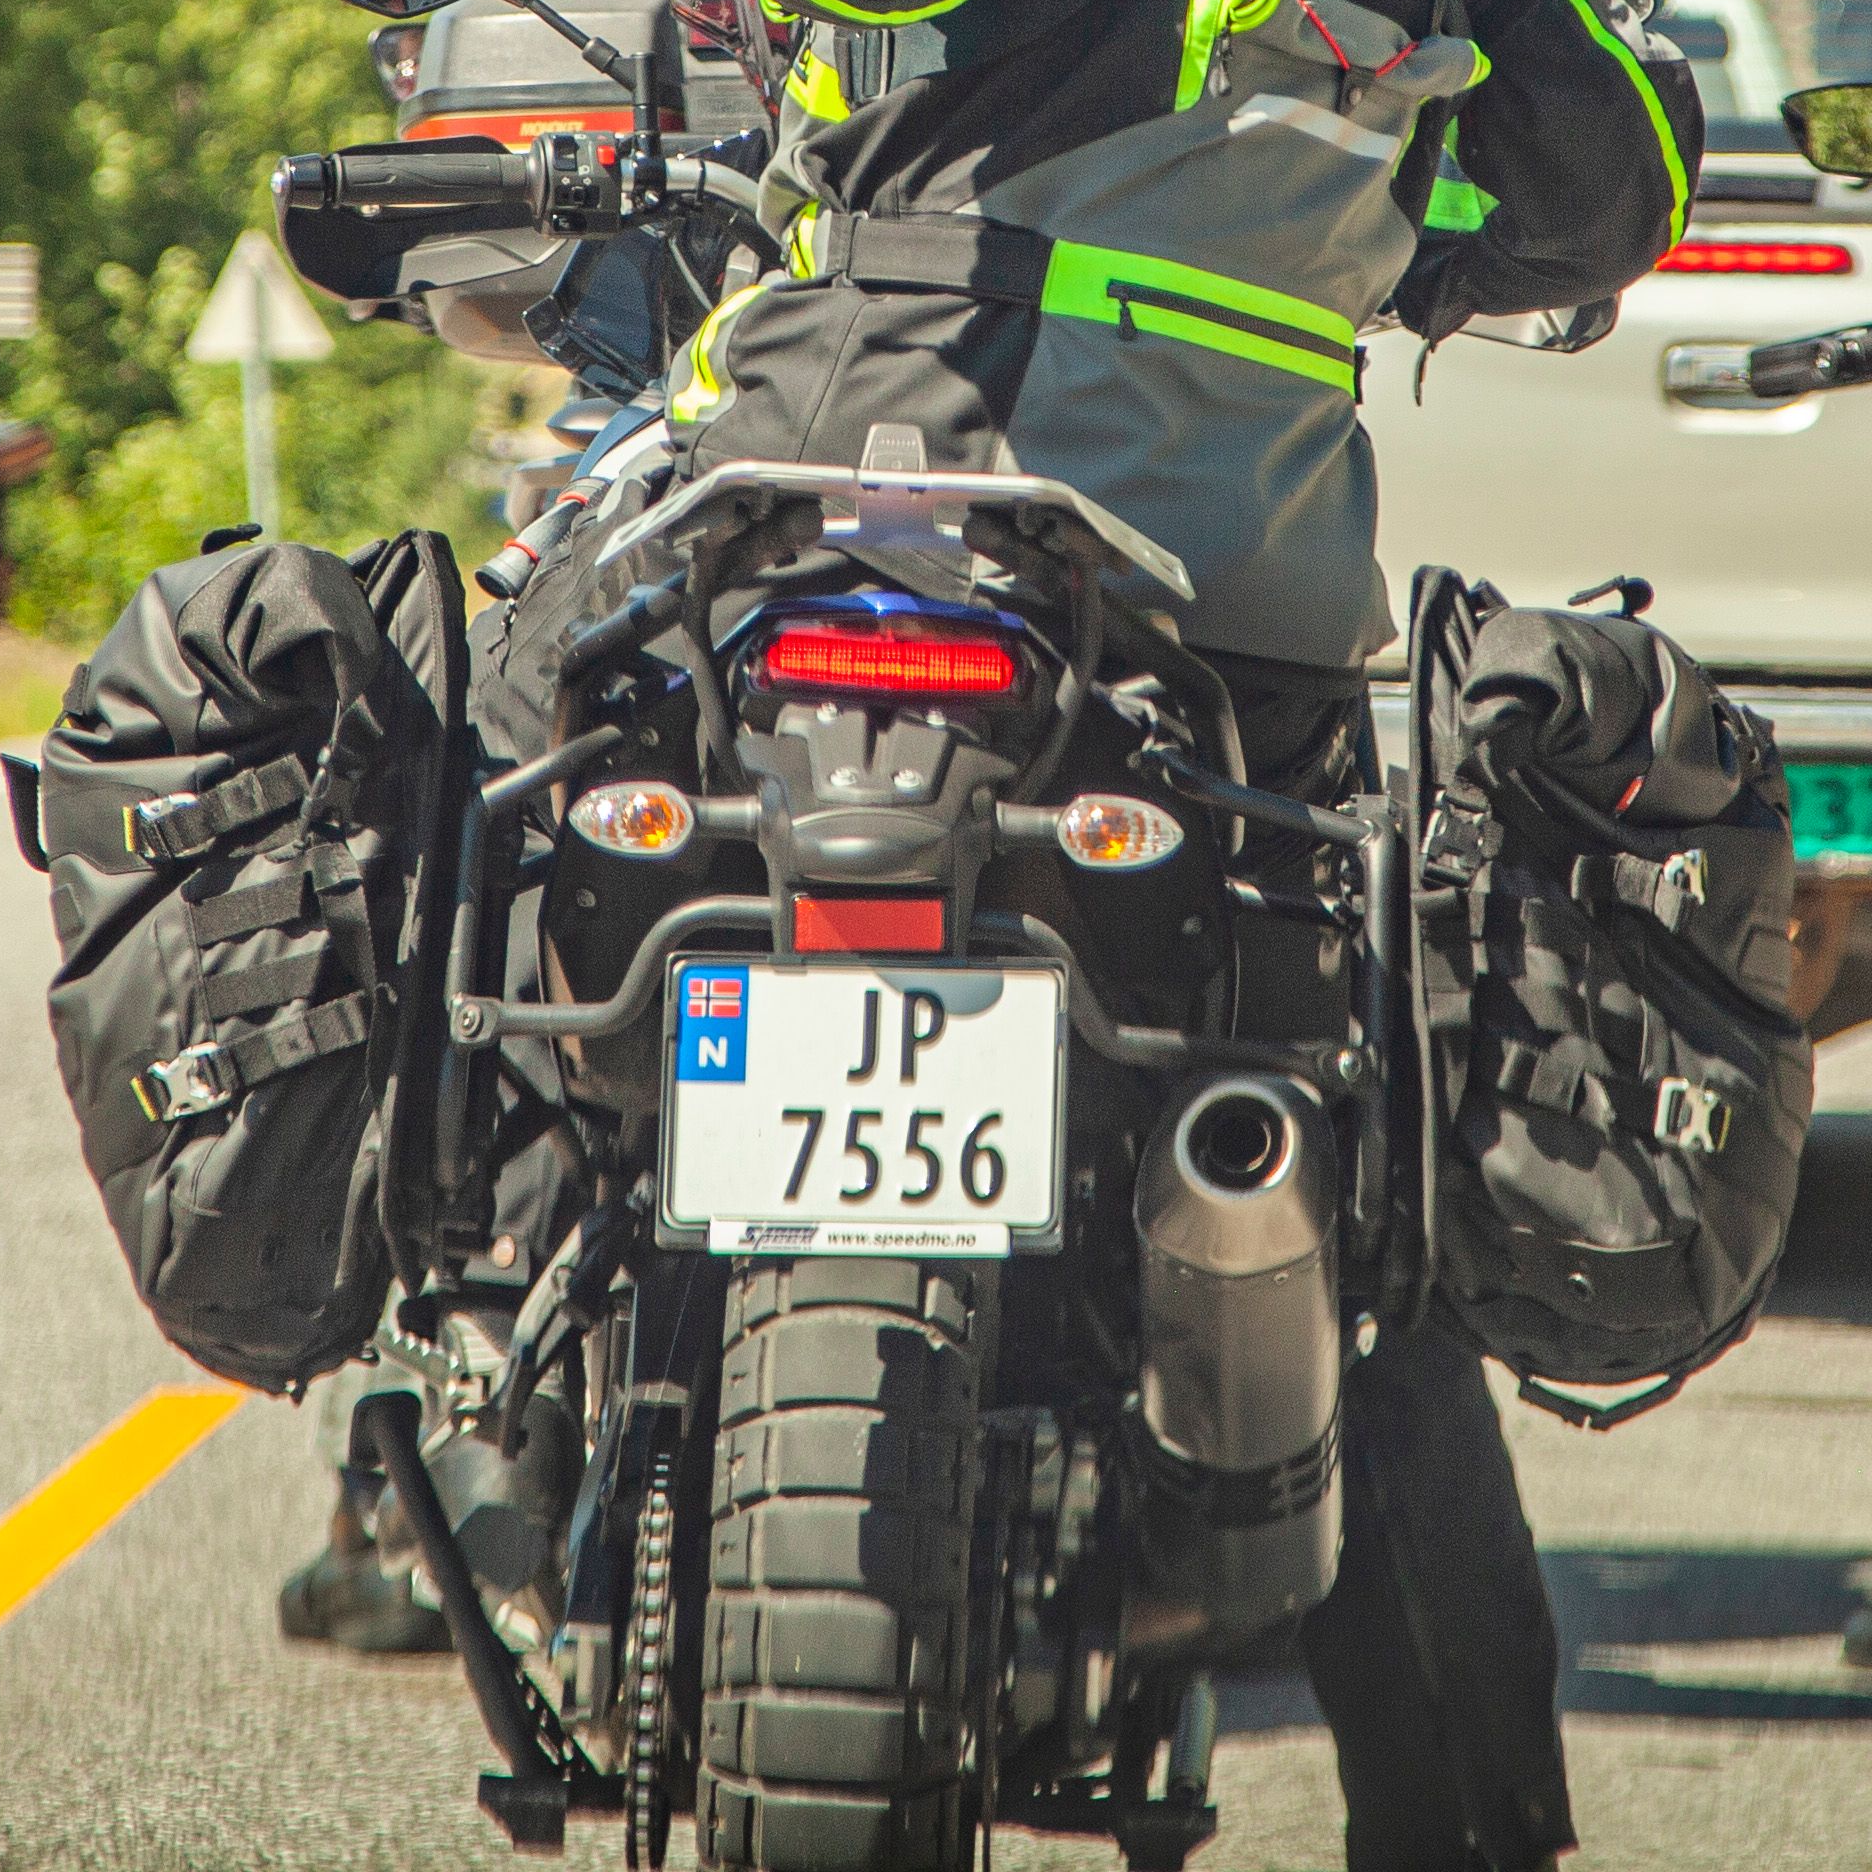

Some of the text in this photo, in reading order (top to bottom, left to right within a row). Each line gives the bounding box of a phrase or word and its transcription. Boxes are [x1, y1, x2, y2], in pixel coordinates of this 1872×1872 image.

[697, 1036, 728, 1068] N
[846, 988, 948, 1085] JP
[781, 1108, 1007, 1205] 7556
[827, 1232, 977, 1249] www.speedmc.no
